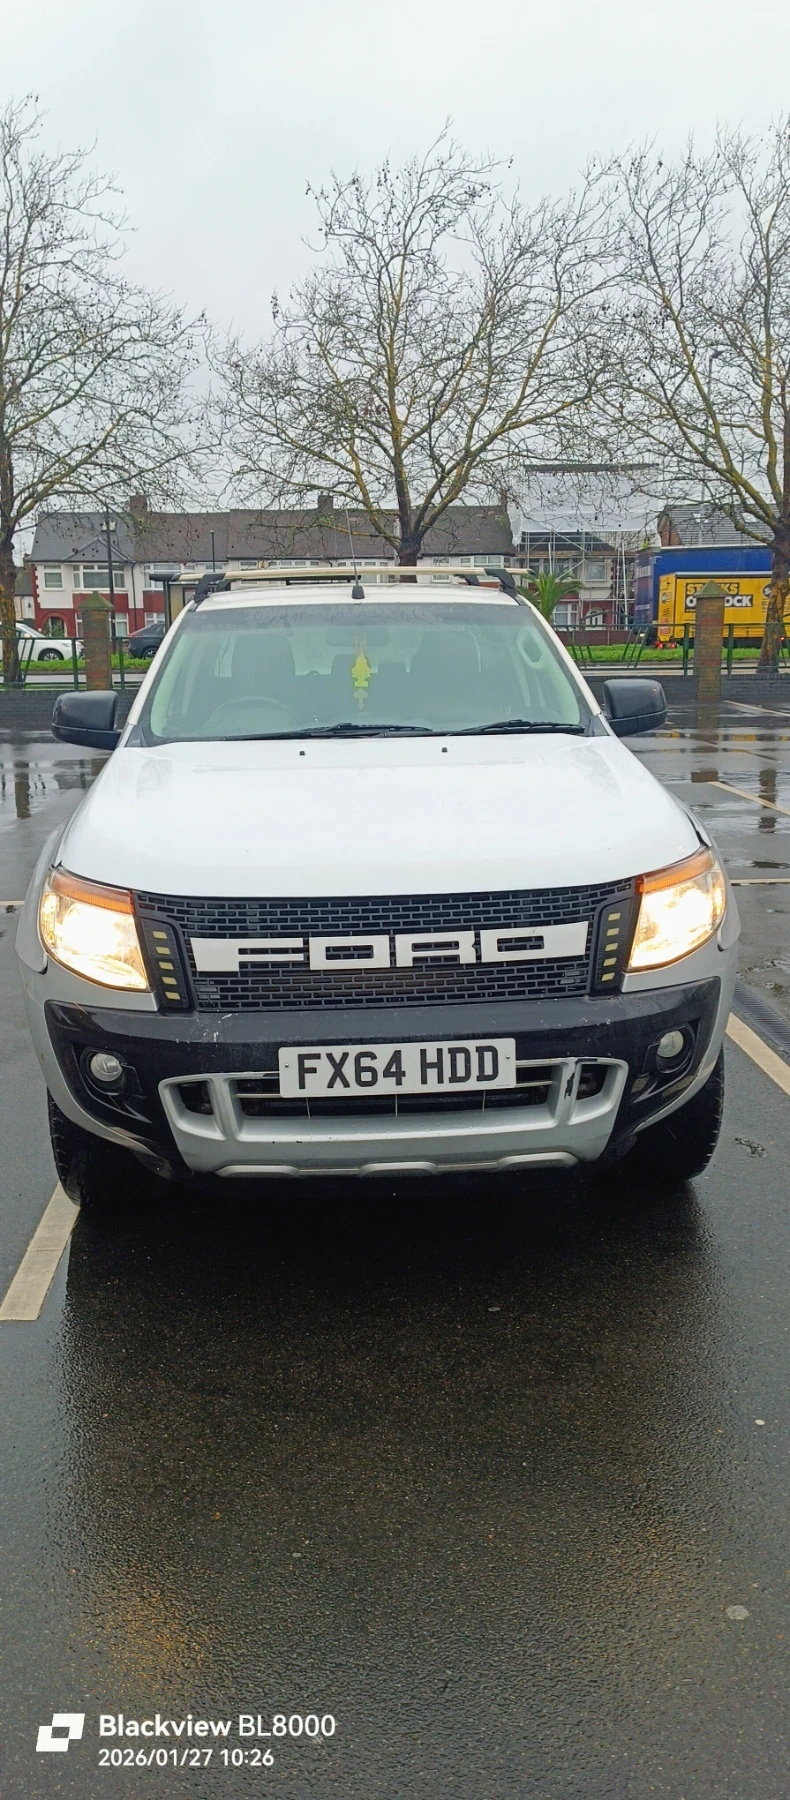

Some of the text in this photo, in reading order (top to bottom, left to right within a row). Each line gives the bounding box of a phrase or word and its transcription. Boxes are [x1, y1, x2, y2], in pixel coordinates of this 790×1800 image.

[686, 583, 738, 595] STKS
[190, 921, 589, 972] FORD
[298, 1045, 499, 1090] FX64 HDD
